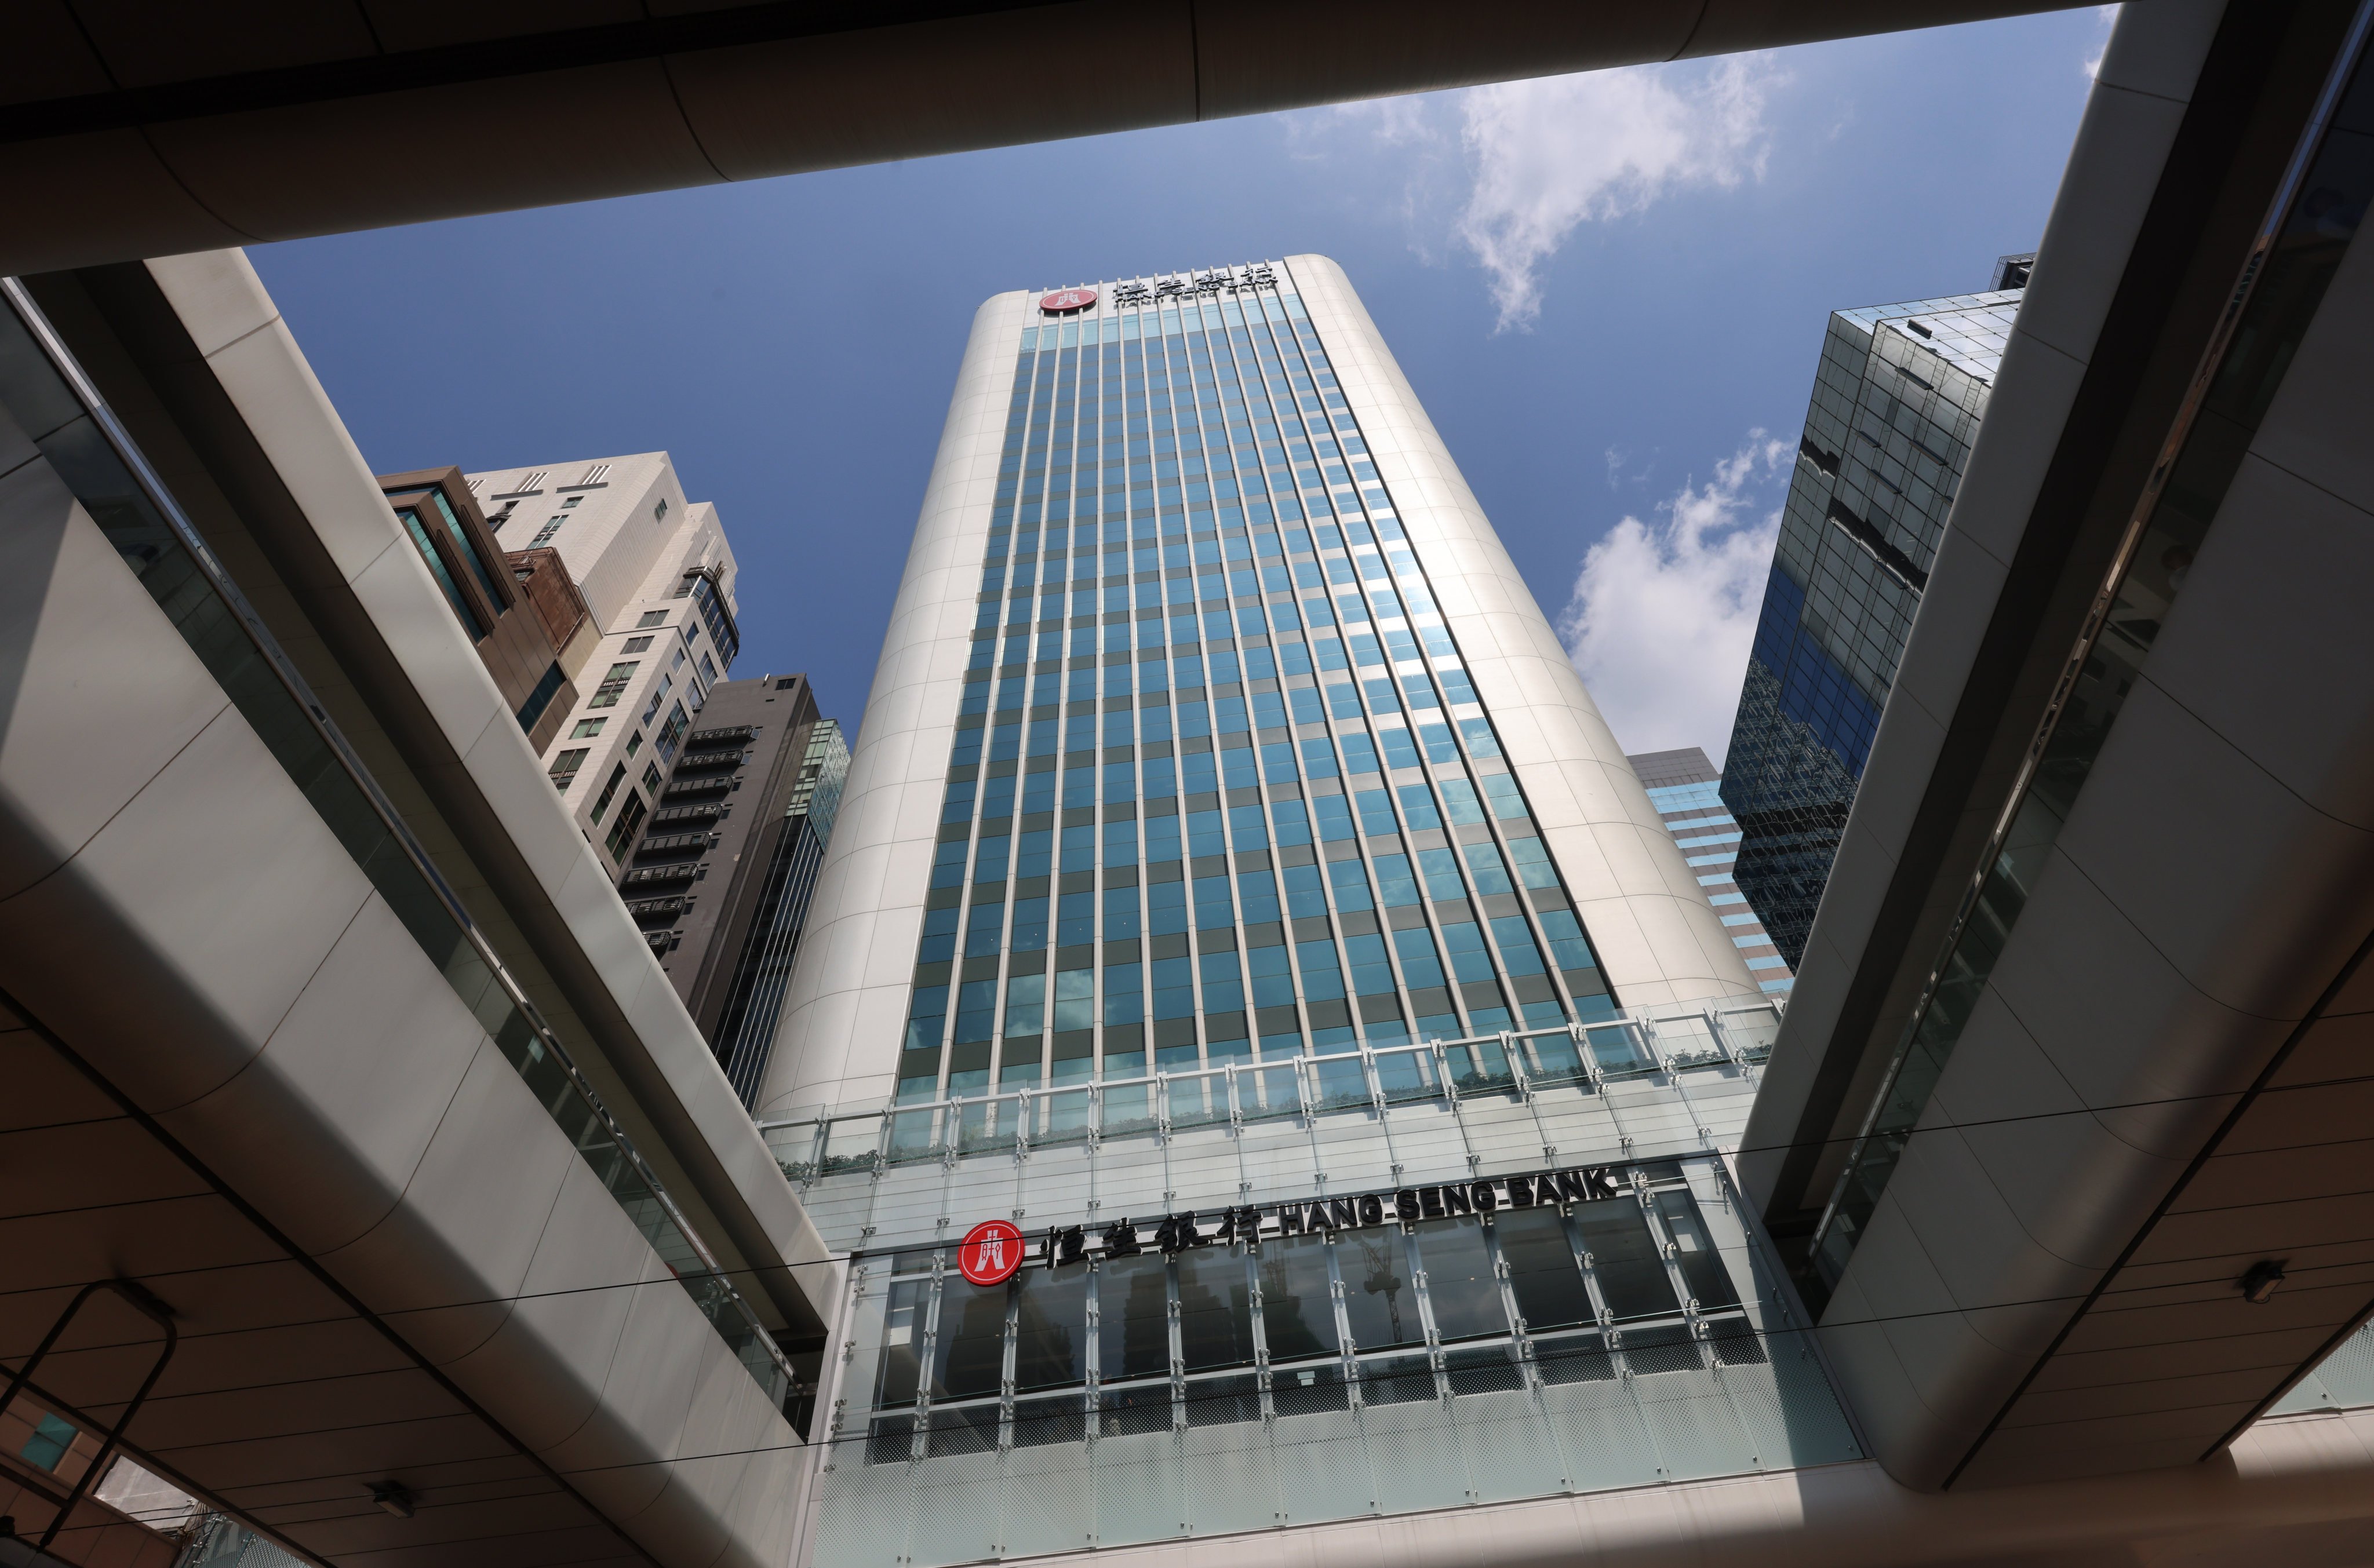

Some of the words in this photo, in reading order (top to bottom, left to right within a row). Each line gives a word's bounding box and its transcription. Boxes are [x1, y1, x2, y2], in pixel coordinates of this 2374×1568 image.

[1113, 267, 1273, 295] 恒生銀行
[1114, 290, 1165, 302] HANG
[1171, 283, 1220, 295] SENG
[1227, 276, 1279, 288] BANK
[1040, 1204, 1264, 1270] 恒生銀行
[1276, 1194, 1383, 1235] HANG
[1393, 1179, 1497, 1220] SENG
[1507, 1166, 1617, 1207] BANK
